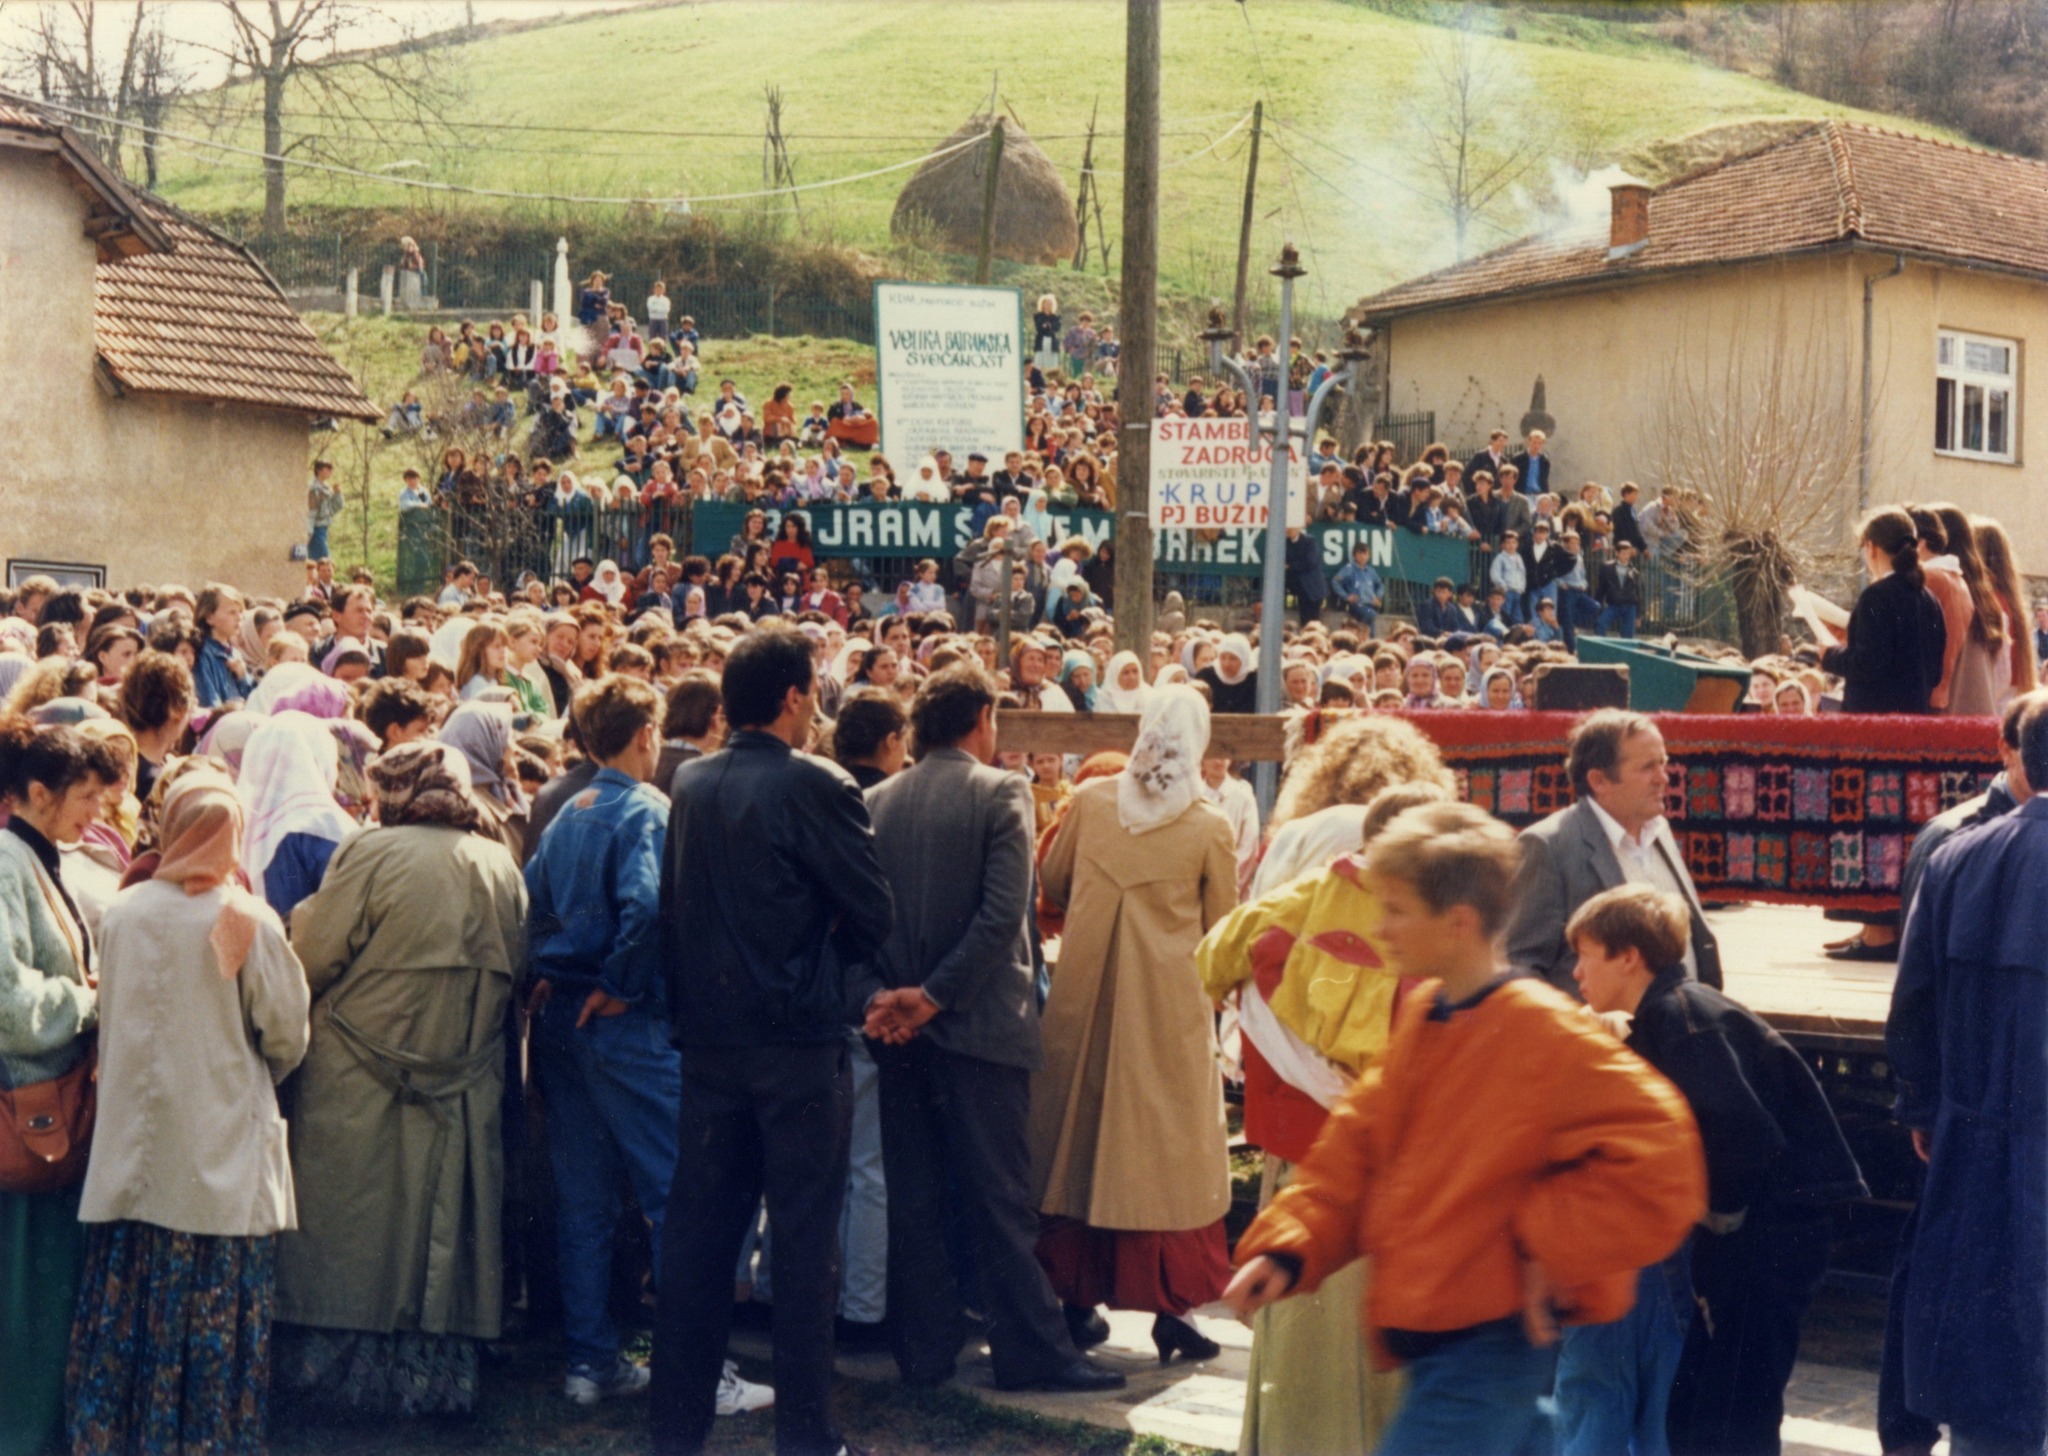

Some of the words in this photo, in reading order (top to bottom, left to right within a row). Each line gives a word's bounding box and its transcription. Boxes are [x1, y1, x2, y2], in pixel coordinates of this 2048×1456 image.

[1159, 422, 1294, 441] STAMBE
[1165, 482, 1262, 504] KRUP
[1160, 505, 1187, 524] PJ
